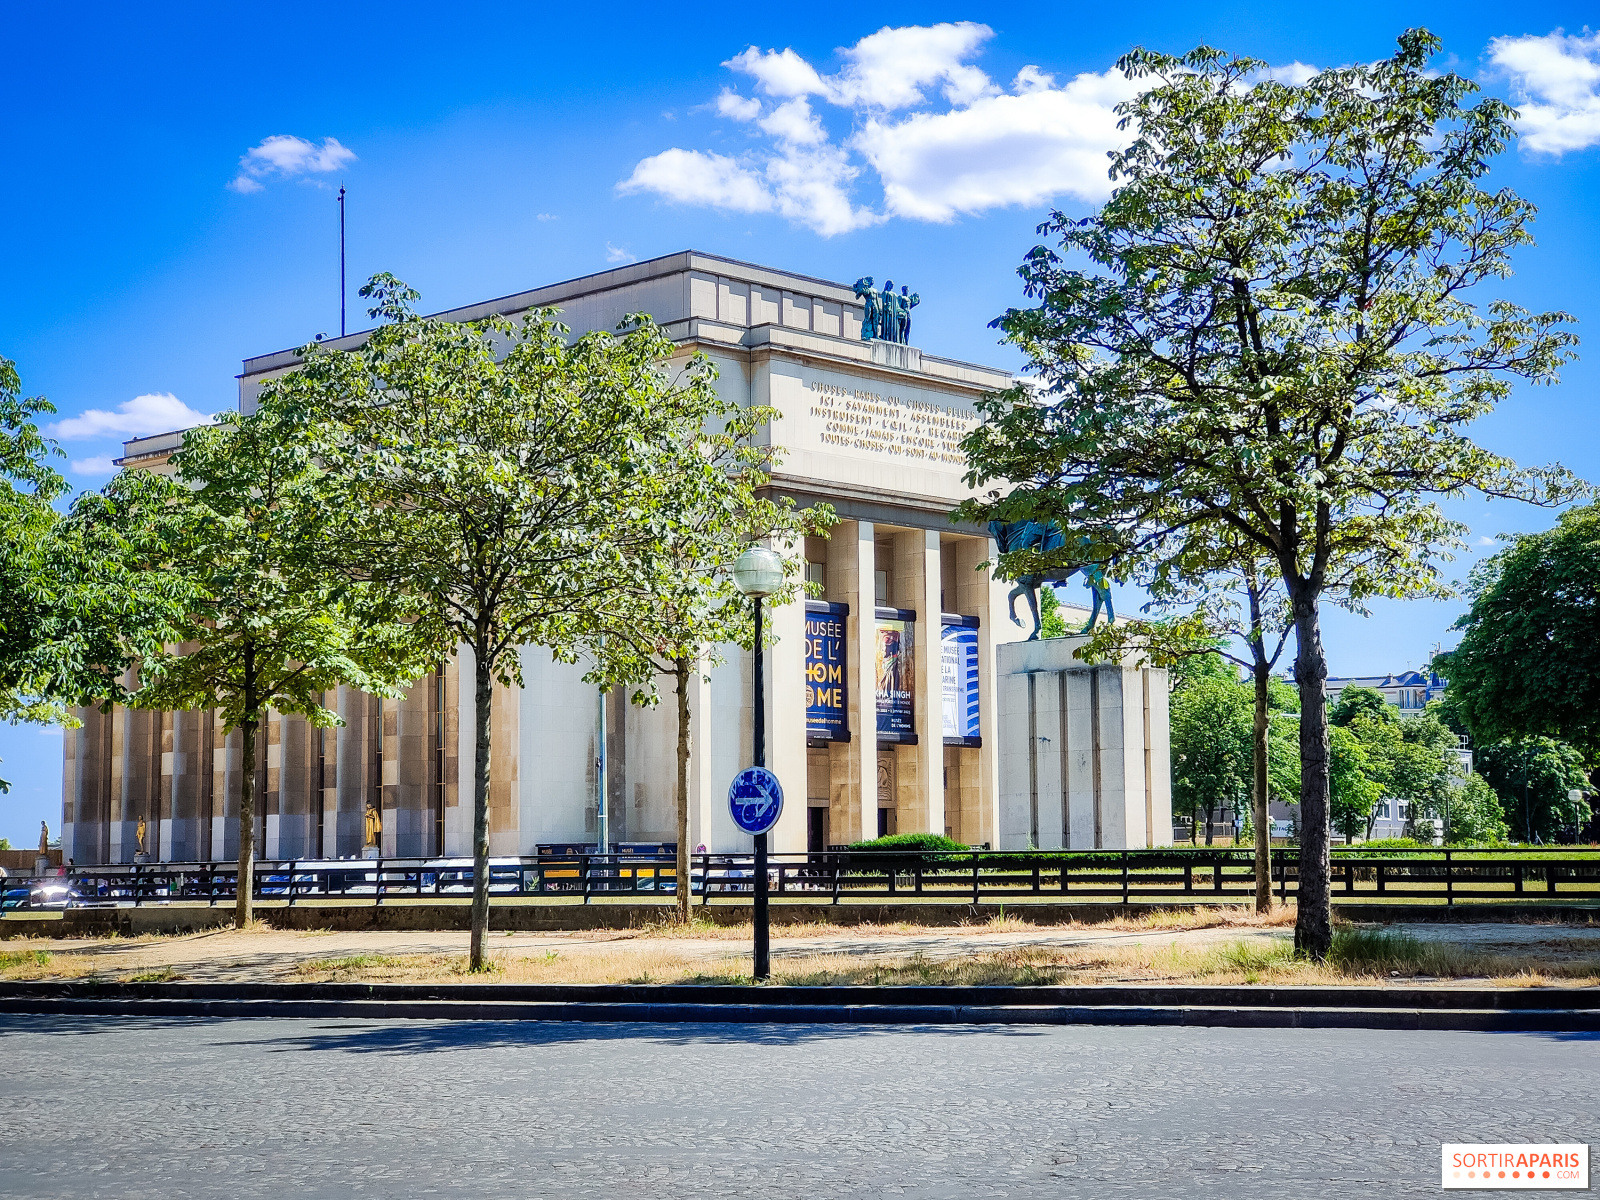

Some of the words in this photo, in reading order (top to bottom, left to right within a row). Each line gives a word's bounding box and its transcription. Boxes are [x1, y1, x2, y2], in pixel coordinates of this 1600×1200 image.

[810, 381, 847, 397] CHOSES
[854, 388, 881, 403] RARES
[887, 395, 900, 407] OU
[906, 399, 940, 414] CHOSES
[946, 406, 976, 420] BELLES
[820, 395, 834, 407] ICI
[845, 400, 900, 419] SAVAMMENT
[810, 406, 872, 426] INSTRUISENT
[928, 427, 964, 442] REGARD
[826, 421, 859, 437] COMME
[865, 428, 894, 442] JAMAIS
[901, 434, 934, 449] ENCORE
[820, 432, 850, 447] TOUTES
[854, 438, 884, 453] CHOSES
[888, 444, 901, 455] QUI
[905, 447, 924, 459] SONT
[928, 451, 939, 461] AU
[828, 640, 840, 660] L'
[941, 656, 960, 666] ATIONAL
[941, 675, 956, 685] ARINE
[945, 665, 951, 674] LA
[890, 690, 911, 700] SINGH
